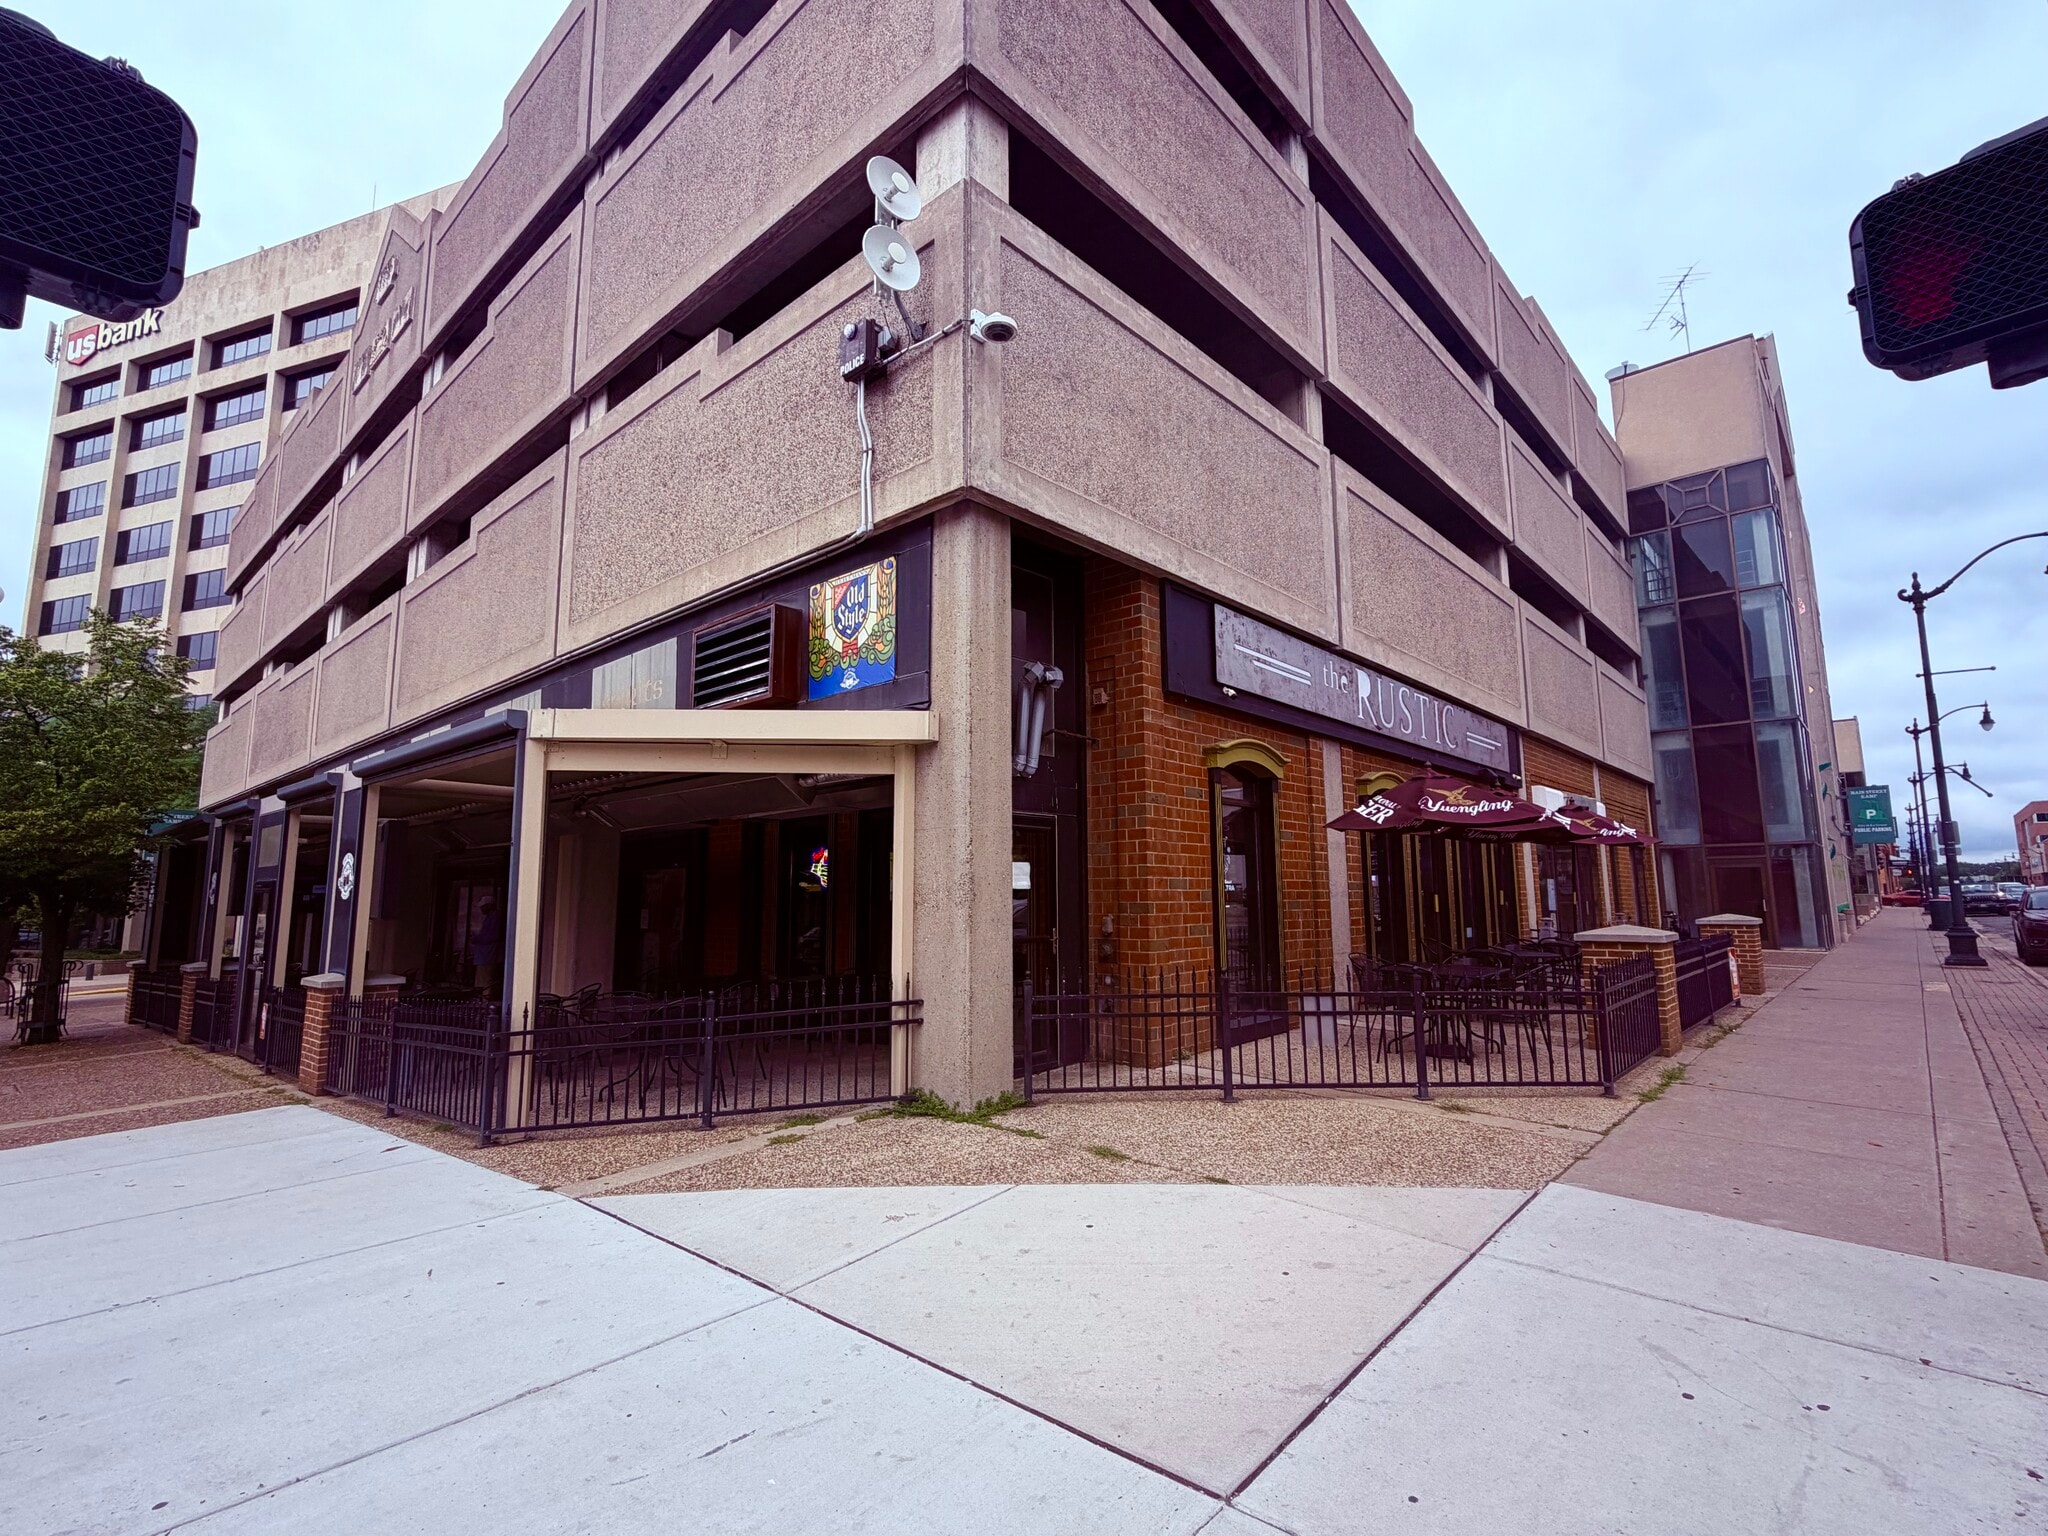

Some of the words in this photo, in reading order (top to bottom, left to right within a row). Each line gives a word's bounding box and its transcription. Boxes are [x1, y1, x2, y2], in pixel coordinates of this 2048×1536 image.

[840, 353, 865, 376] POLICE
[846, 582, 865, 607] Old
[837, 604, 867, 634] Style
[1323, 660, 1349, 694] the
[1355, 668, 1457, 749] RUSTIC
[1418, 795, 1515, 816] Yuengling
[1865, 809, 1877, 820] P
